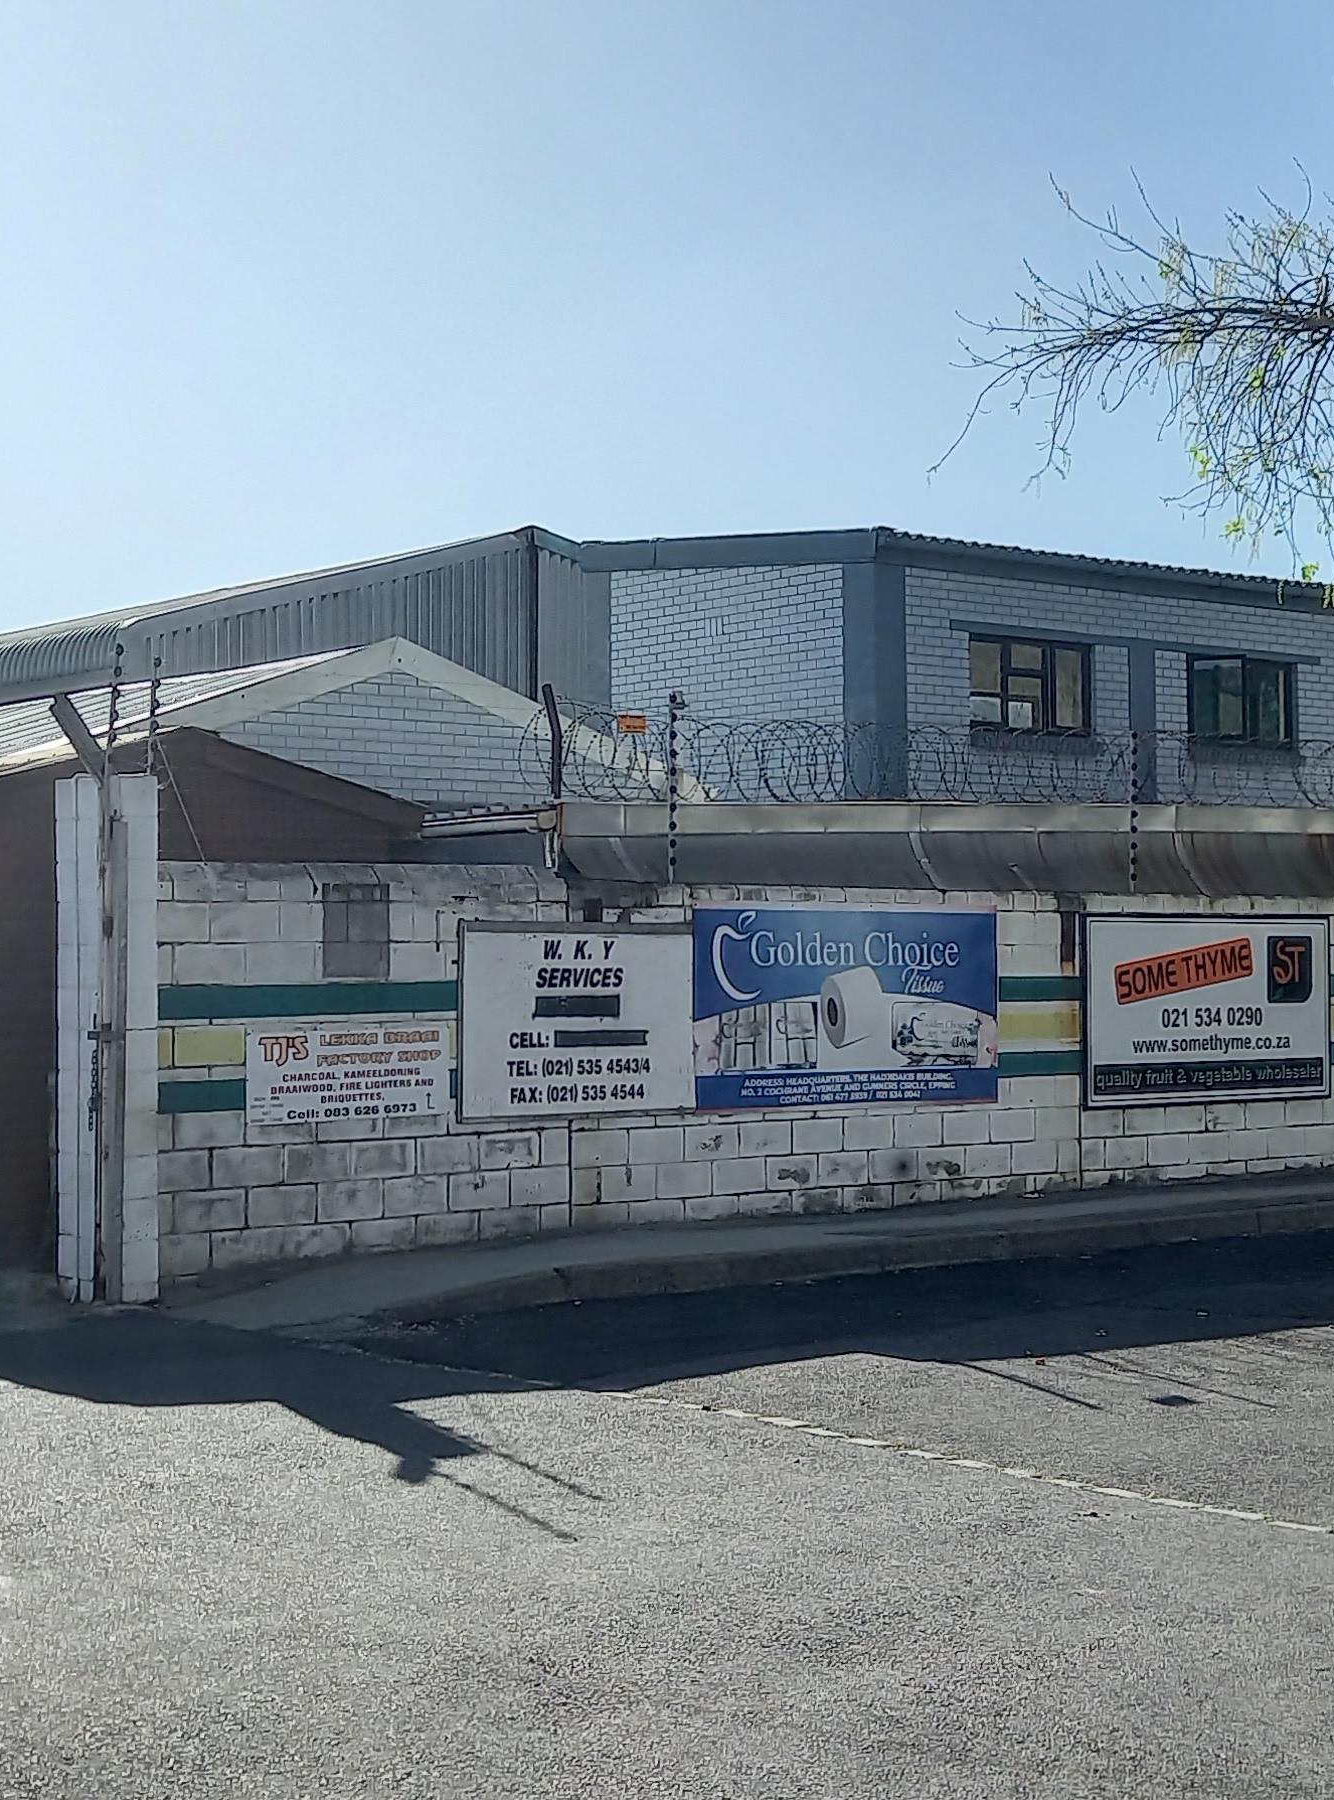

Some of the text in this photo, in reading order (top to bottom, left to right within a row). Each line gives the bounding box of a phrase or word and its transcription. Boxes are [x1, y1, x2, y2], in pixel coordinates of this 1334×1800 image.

[543, 940, 615, 960] W. K. Y
[750, 930, 959, 968] Golden Choice
[1117, 944, 1251, 1000] SOME THYME
[1273, 940, 1306, 984] ST
[536, 967, 623, 988] SERVICES
[901, 965, 945, 994] Tissue
[1162, 1007, 1262, 1028] 021 534 0290
[320, 1031, 439, 1047] LEKKA BRAAI
[510, 1032, 549, 1049] CELL:
[1132, 1034, 1291, 1054] www.somethyme.co.za
[258, 1035, 309, 1067] TJ'S
[317, 1050, 442, 1067] FACTORY SHOP
[283, 1068, 421, 1082] CHARCOAL, KAMEELDORING
[507, 1057, 650, 1077] TEL: (021) 535 4543/4
[1096, 1069, 1142, 1089] quality
[1145, 1069, 1173, 1084] fruit
[1190, 1066, 1252, 1085] vegetable
[1256, 1064, 1321, 1080] wholesaler
[271, 1078, 434, 1095] BRAAIWOOD, FIRE LIGHTERS AND
[744, 1078, 784, 1087] ADDRESS:
[810, 1084, 842, 1093] AVENUE
[844, 1083, 860, 1091] AND
[510, 1084, 644, 1104] FAX: (021) 535 4544
[324, 1108, 349, 1118] 083
[355, 1106, 379, 1116] 626
[384, 1103, 416, 1113] 6973
